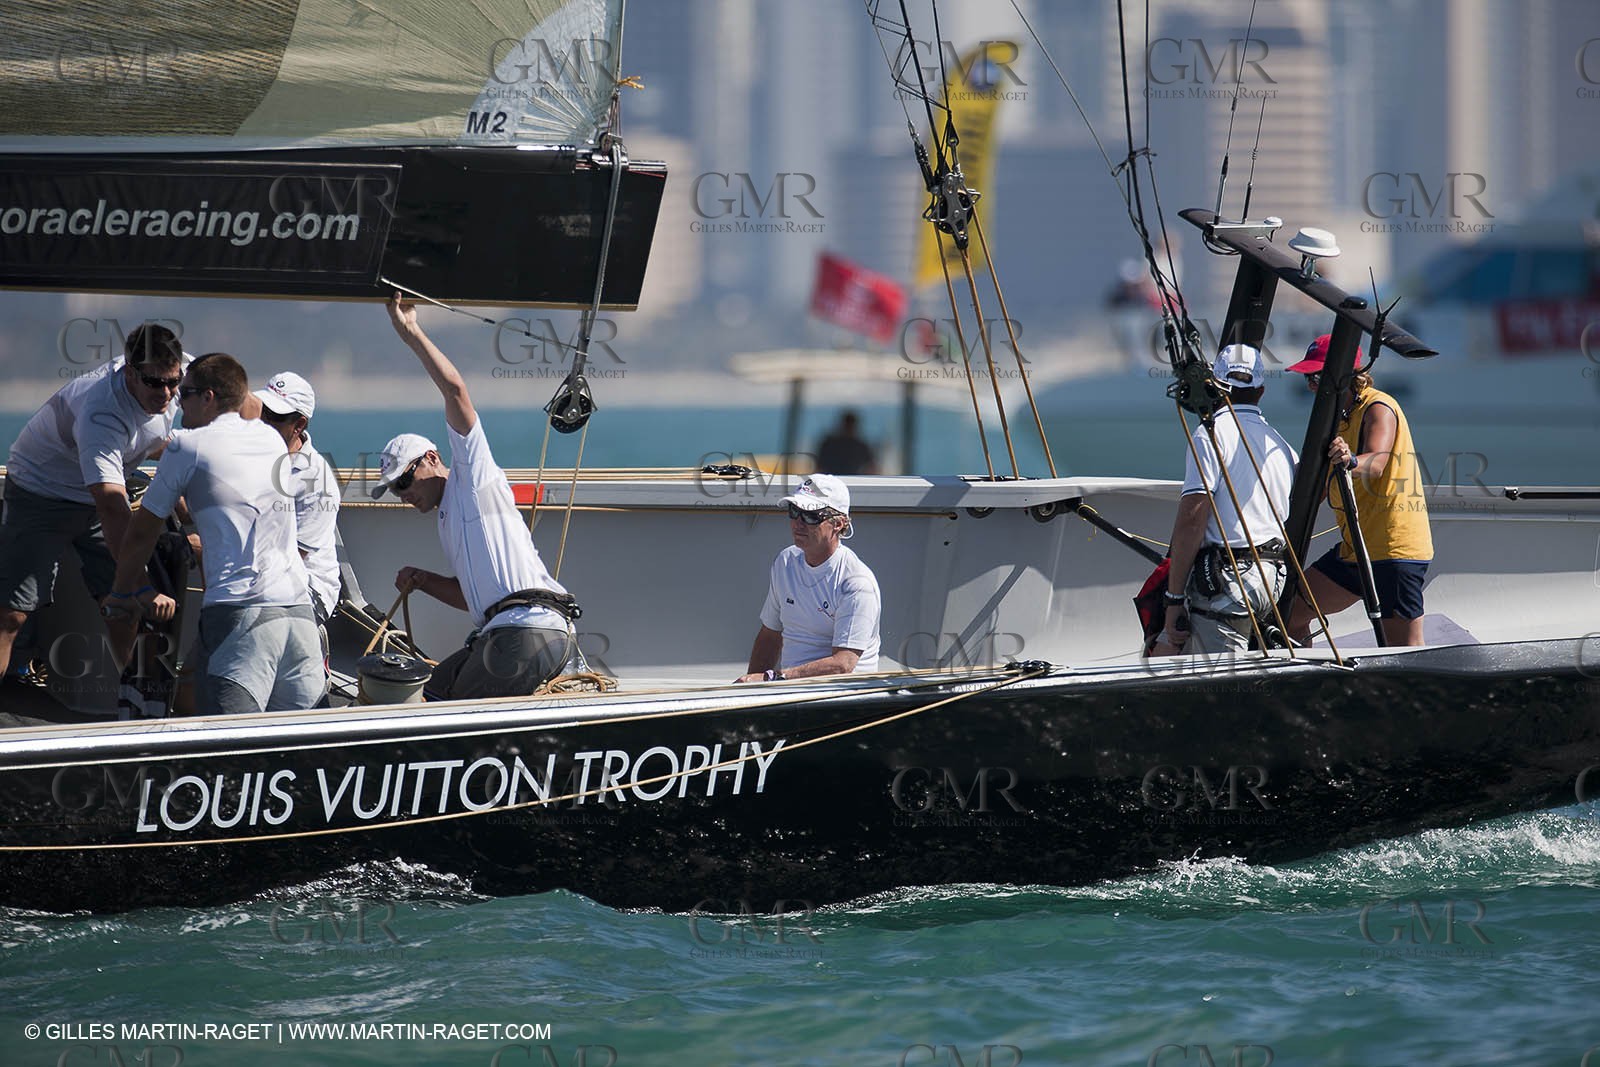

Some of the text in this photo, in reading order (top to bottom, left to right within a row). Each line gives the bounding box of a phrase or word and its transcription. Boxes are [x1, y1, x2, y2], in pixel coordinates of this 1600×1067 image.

[466, 111, 508, 134] M2
[0, 199, 361, 246] oracleracing.com
[135, 740, 787, 832] LOUIS VUITTON TROPHY
